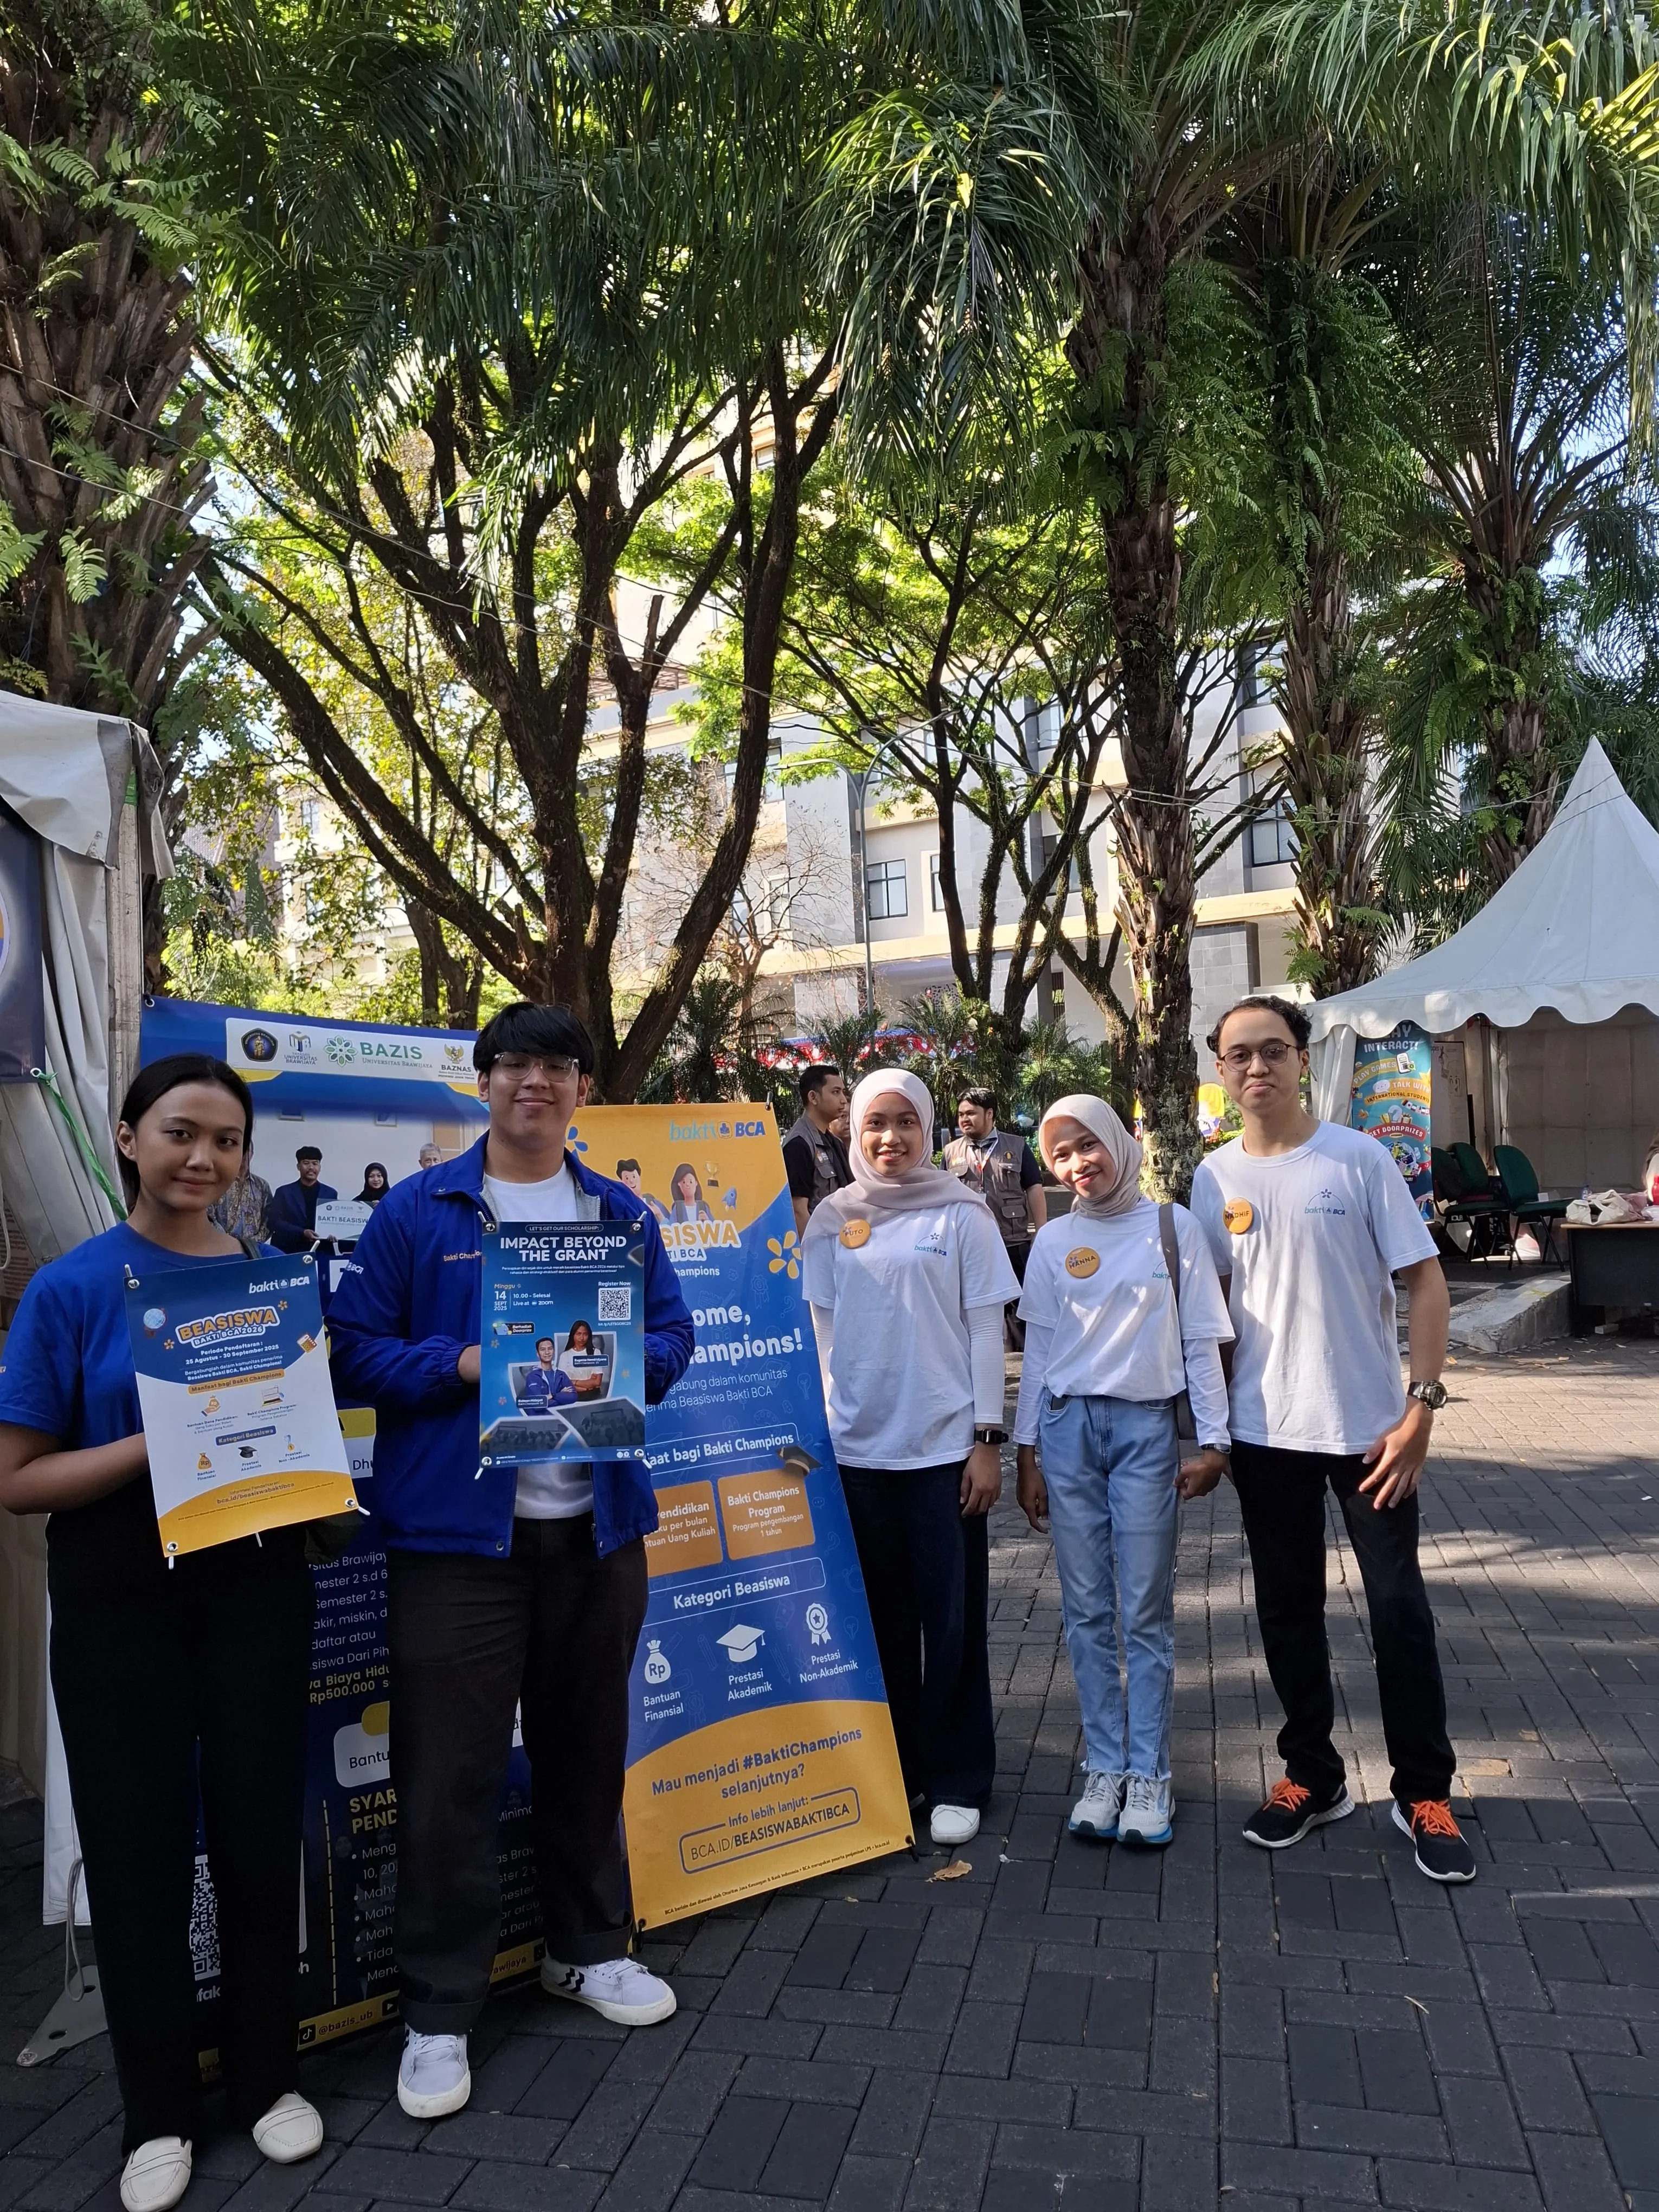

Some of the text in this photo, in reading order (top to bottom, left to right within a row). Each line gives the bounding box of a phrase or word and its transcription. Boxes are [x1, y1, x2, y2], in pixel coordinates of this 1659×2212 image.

[360, 1042, 422, 1059] BAZIS
[1364, 1040, 1419, 1053] INTERACT!
[362, 1058, 400, 1066] UNIVERSITAS
[1354, 1062, 1396, 1084] PLAY GAMES
[1413, 1082, 1430, 1094] WITH
[1367, 1092, 1406, 1103] INTERNATIONAL
[669, 1121, 766, 1141] bakti BCA
[1369, 1126, 1423, 1137] GET DOORPRIZES
[1225, 1211, 1250, 1220] NADHIF
[1304, 1206, 1324, 1214] bakti
[500, 1236, 627, 1249] IMPACT BEYOND
[914, 1245, 932, 1253] bakti
[443, 1253, 458, 1262] Bakti
[519, 1249, 608, 1262] THE GRANT
[680, 1249, 704, 1258] BCA
[1069, 1255, 1096, 1269] HANNA
[249, 1276, 310, 1294] bakti BCA
[494, 1291, 506, 1300] 14
[691, 1305, 751, 1327] ome,
[178, 1308, 278, 1341] BEASISWA
[194, 1325, 262, 1346] BAKTI BCA 2026
[224, 1342, 259, 1351] Pendaftaran
[195, 1354, 218, 1364] Agustus
[232, 1347, 263, 1356] September
[185, 1366, 219, 1375] Bergabunglah
[709, 1369, 788, 1387] dalam komunitas
[191, 1383, 217, 1392] Manfaat
[249, 1372, 281, 1381] Champions
[679, 1386, 773, 1408] Beasiswa Bakti BCA
[218, 1429, 273, 1443] Kategori Beasiswa
[673, 1433, 794, 1462] bagi Bakti Champions
[728, 1487, 800, 1507] Bakti Champions
[657, 1502, 709, 1519] endidikan
[748, 1504, 785, 1519] Program
[670, 1516, 708, 1532] per bulan
[732, 1513, 804, 1533] Program pengembangan
[668, 1526, 716, 1542] Uang Kuliah
[766, 1528, 782, 1536] tahun
[353, 1569, 388, 1584] 2 s.d 6
[370, 1590, 377, 1600] 2
[673, 1574, 790, 1610] Kategori Beasiswa
[339, 1611, 377, 1626] miskin,
[349, 1630, 376, 1643] atau
[347, 1646, 389, 1663] Dari Pih
[811, 1649, 841, 1666] Prestasi
[648, 1662, 666, 1677] Rp
[728, 1668, 764, 1685] Prestasi
[800, 1660, 859, 1683] Non-Akademik
[326, 1671, 361, 1686] Biaya
[309, 1681, 375, 1705] Rp500.000
[644, 1691, 681, 1707] Bantuan
[728, 1682, 773, 1701] Akademik
[644, 1703, 684, 1722] Finansial
[349, 1751, 389, 1769] Bantu
[652, 1728, 862, 1797] Mau menjadi #BaktiChampions
[721, 1763, 806, 1799] selanjutnya?
[349, 1788, 397, 1813] SYAR
[729, 1796, 809, 1829] Info lebih lanjut:
[691, 1802, 850, 1861] BCA.ID/BEASISWABAKTIBCA
[362, 1843, 396, 1860] Meng
[363, 1867, 378, 1880] 10,
[366, 1925, 393, 1941] Mah
[366, 1946, 393, 1962] Tida
[319, 2010, 374, 2035] @bazis_ub
